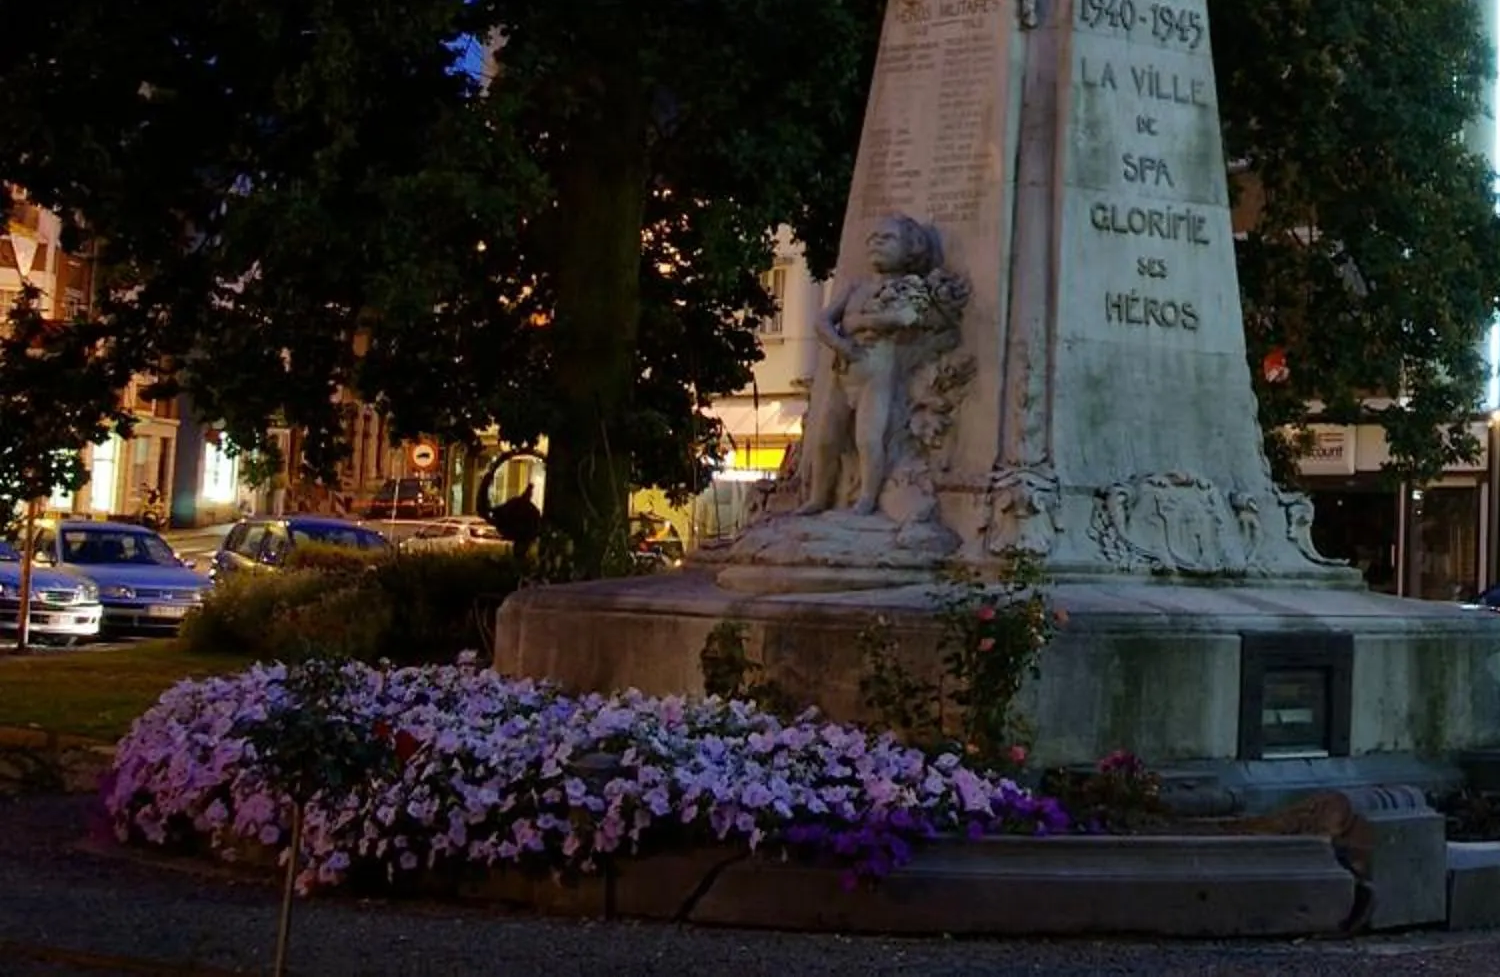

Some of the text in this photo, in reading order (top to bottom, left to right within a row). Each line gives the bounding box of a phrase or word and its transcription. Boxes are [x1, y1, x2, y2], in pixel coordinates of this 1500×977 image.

[1081, 56, 1117, 90] LA
[1136, 114, 1159, 136] DE
[1122, 152, 1175, 187] SPA
[1090, 202, 1210, 245] GLORIFIE
[1137, 256, 1168, 279] SES
